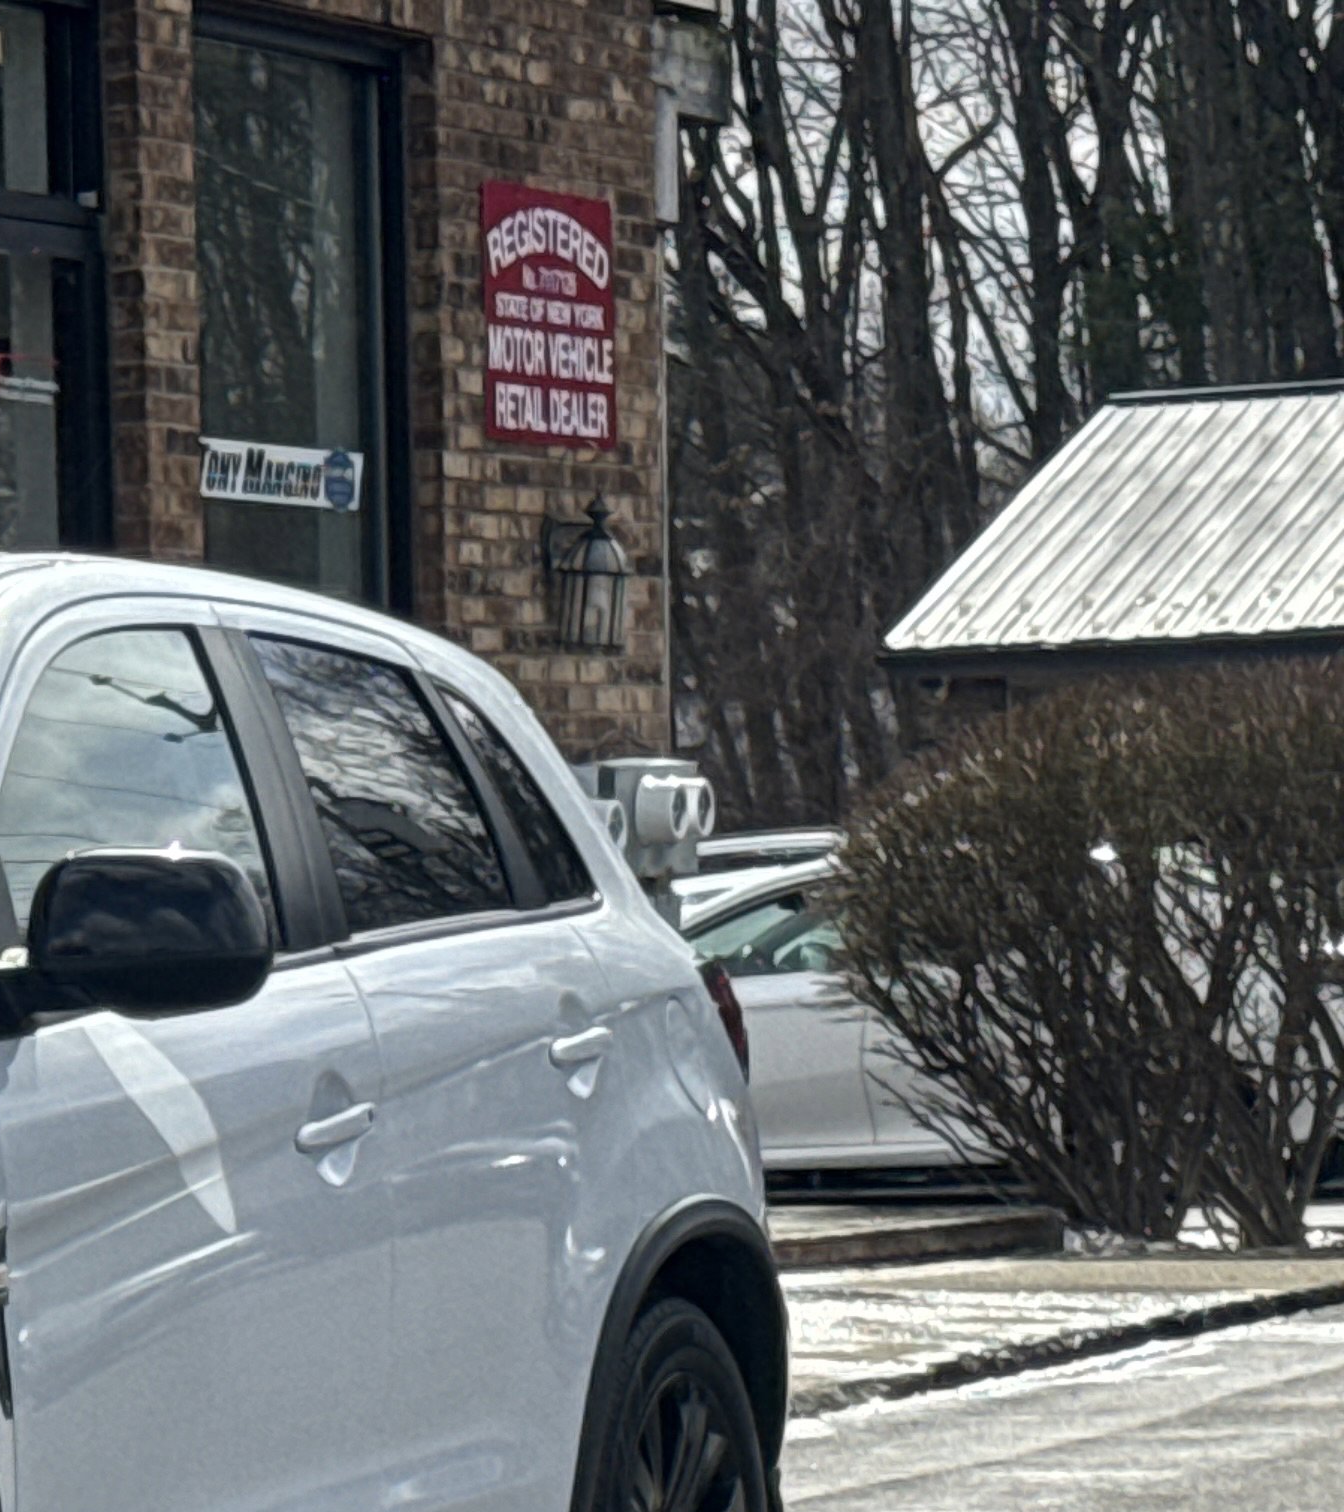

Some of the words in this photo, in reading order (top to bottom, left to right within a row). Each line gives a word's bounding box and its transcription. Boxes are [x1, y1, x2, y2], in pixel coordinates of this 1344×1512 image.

[486, 207, 610, 290] REGISTERED
[488, 323, 547, 377] MOTOR
[547, 331, 614, 385] VEHICLE
[494, 380, 547, 433] RETAIL
[549, 387, 610, 439] DEALER
[205, 449, 243, 494] ONY
